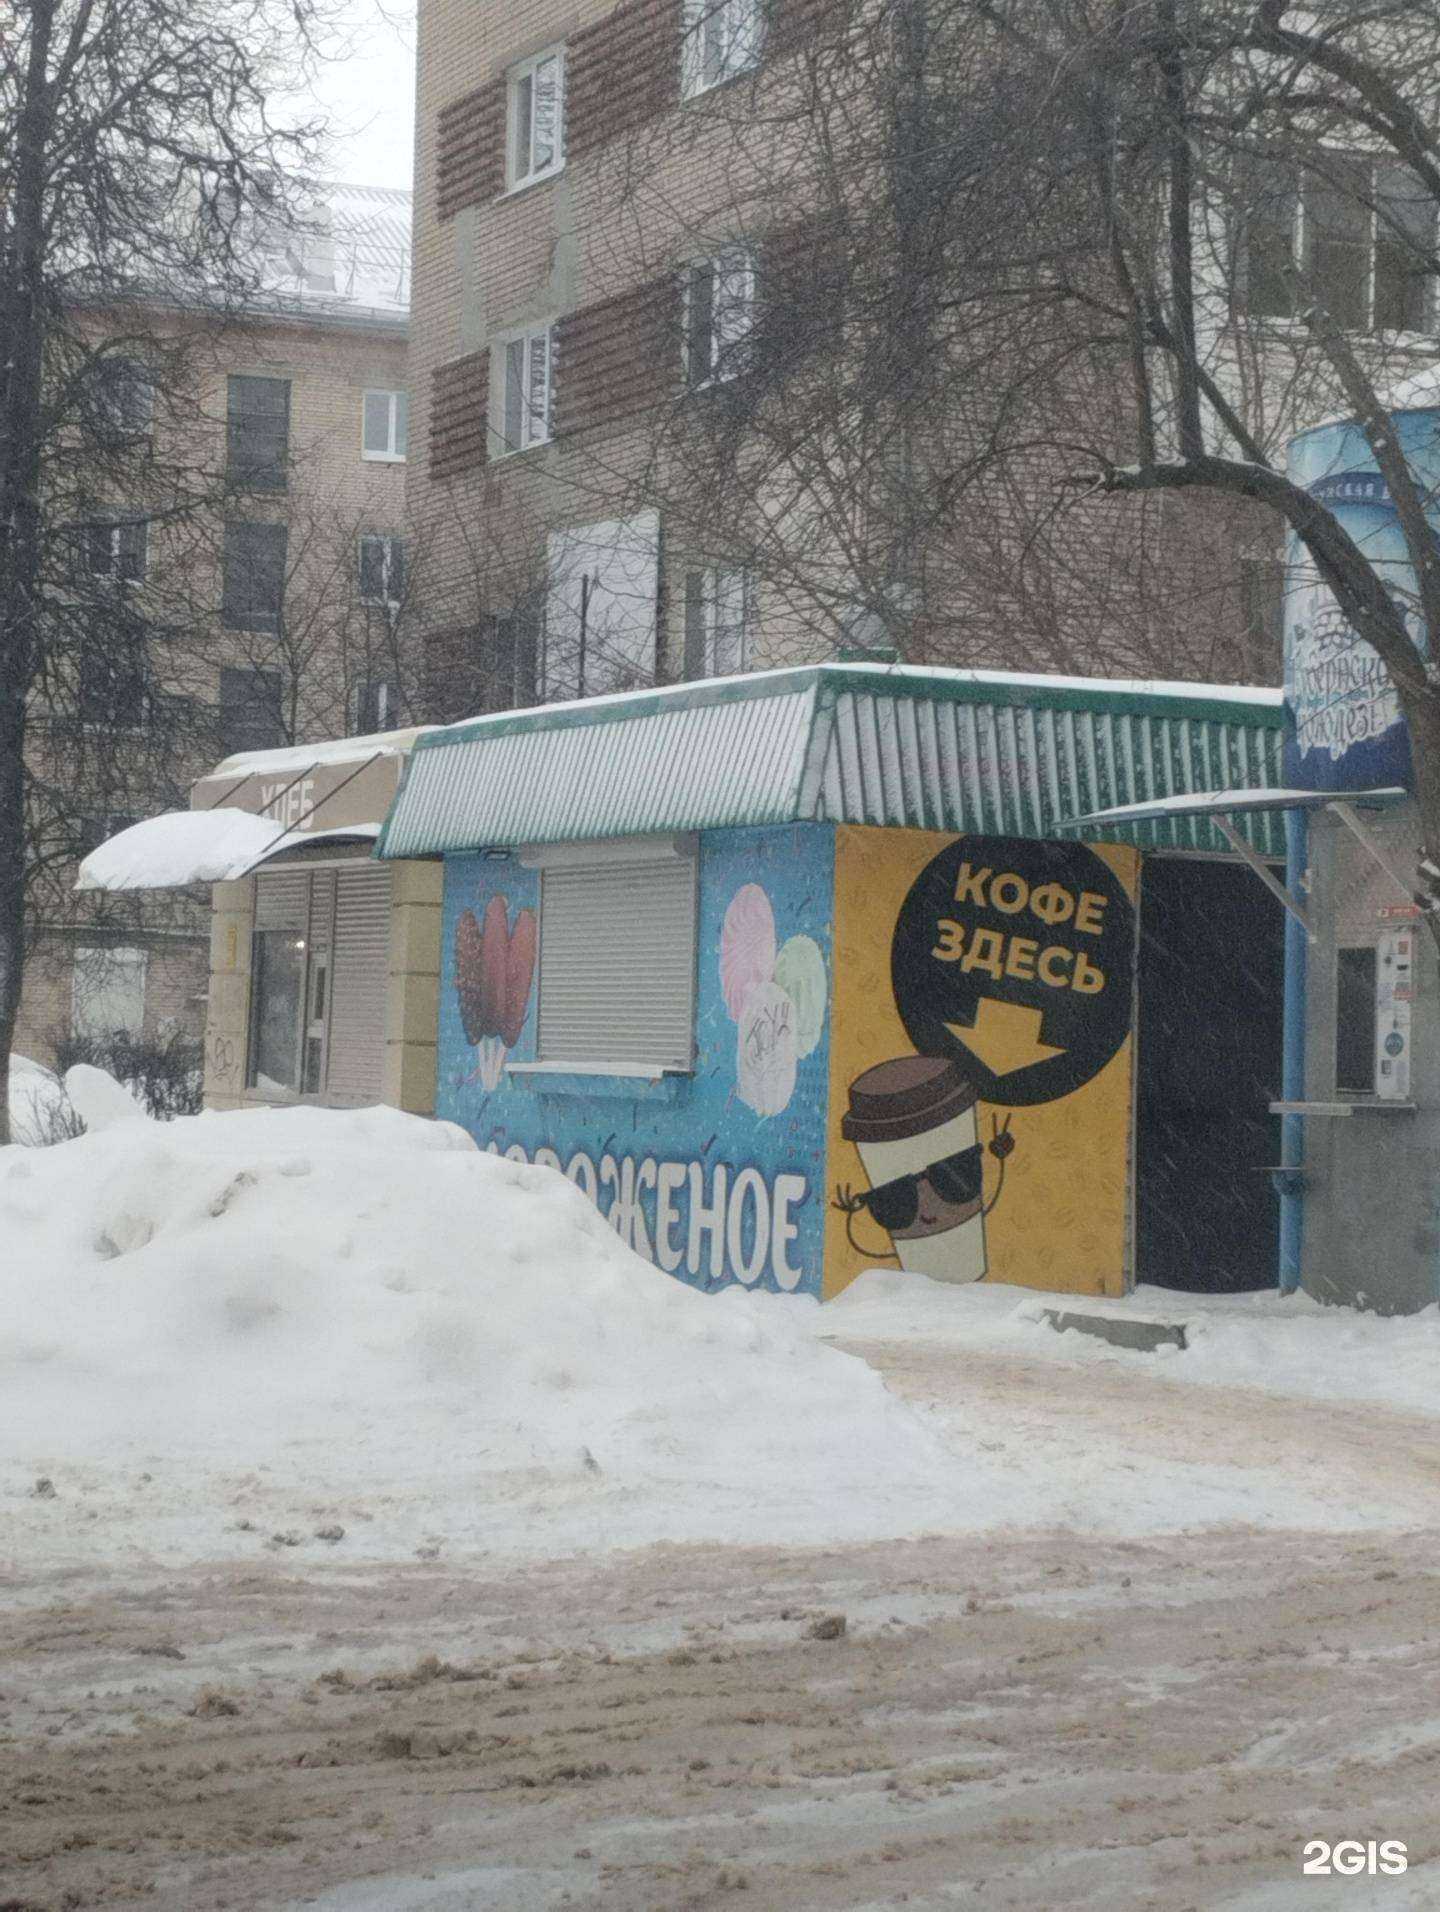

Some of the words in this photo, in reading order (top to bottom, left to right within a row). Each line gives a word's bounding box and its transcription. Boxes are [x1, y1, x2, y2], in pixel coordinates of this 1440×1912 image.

[953, 862, 1109, 936] КОФЕ
[930, 918, 1106, 994] ЗДЕСЬ
[486, 1141, 806, 1291] ЖЕНОЕ
